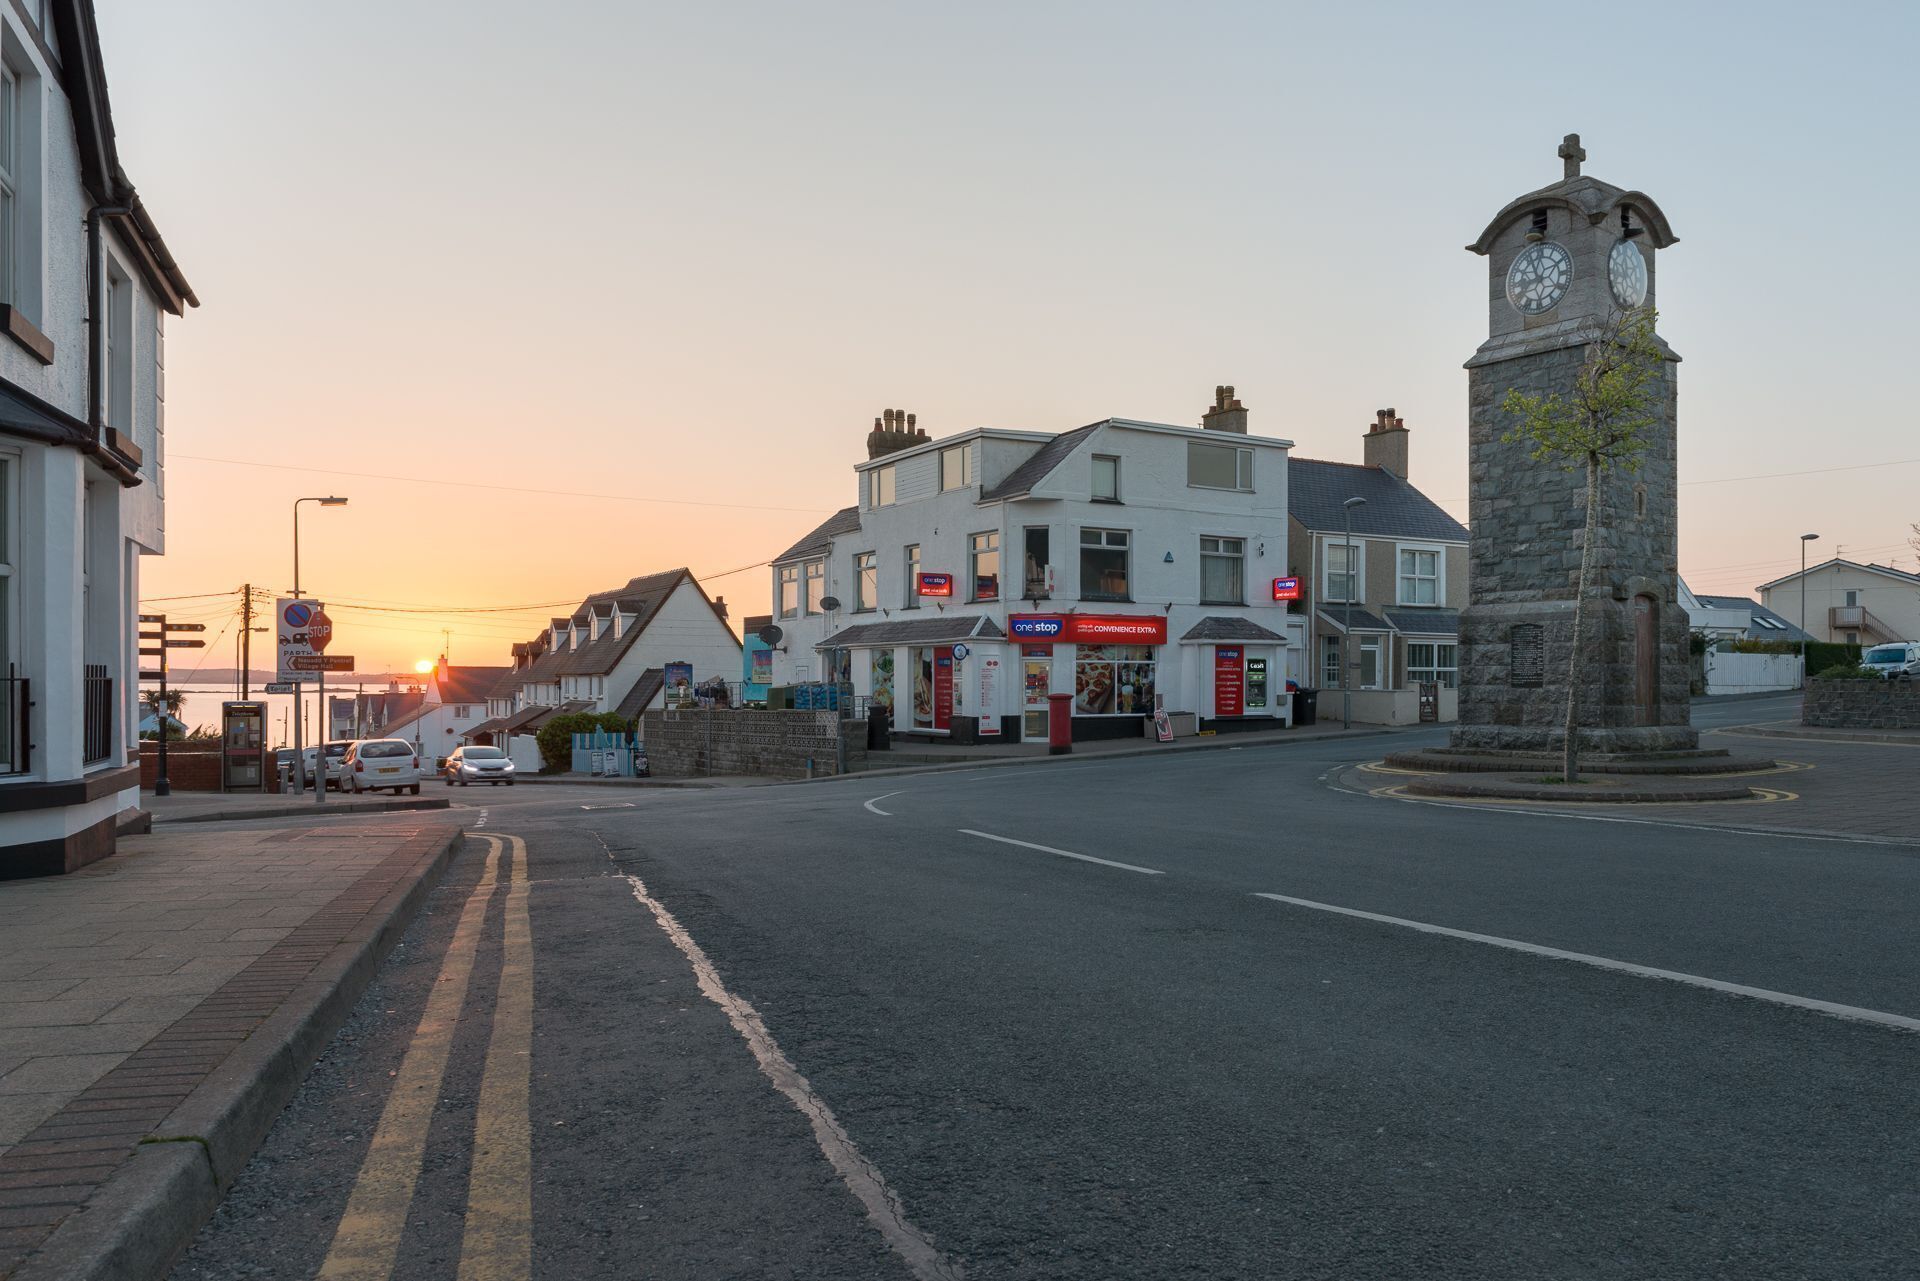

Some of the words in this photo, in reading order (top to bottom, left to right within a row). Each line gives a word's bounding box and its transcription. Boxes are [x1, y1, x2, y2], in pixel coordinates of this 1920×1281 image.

[309, 625, 330, 638] STOP
[1015, 624, 1033, 632] one
[1035, 622, 1058, 634] stop
[1094, 625, 1137, 634] CONVENIENCE
[1137, 626, 1157, 634] EXTRA
